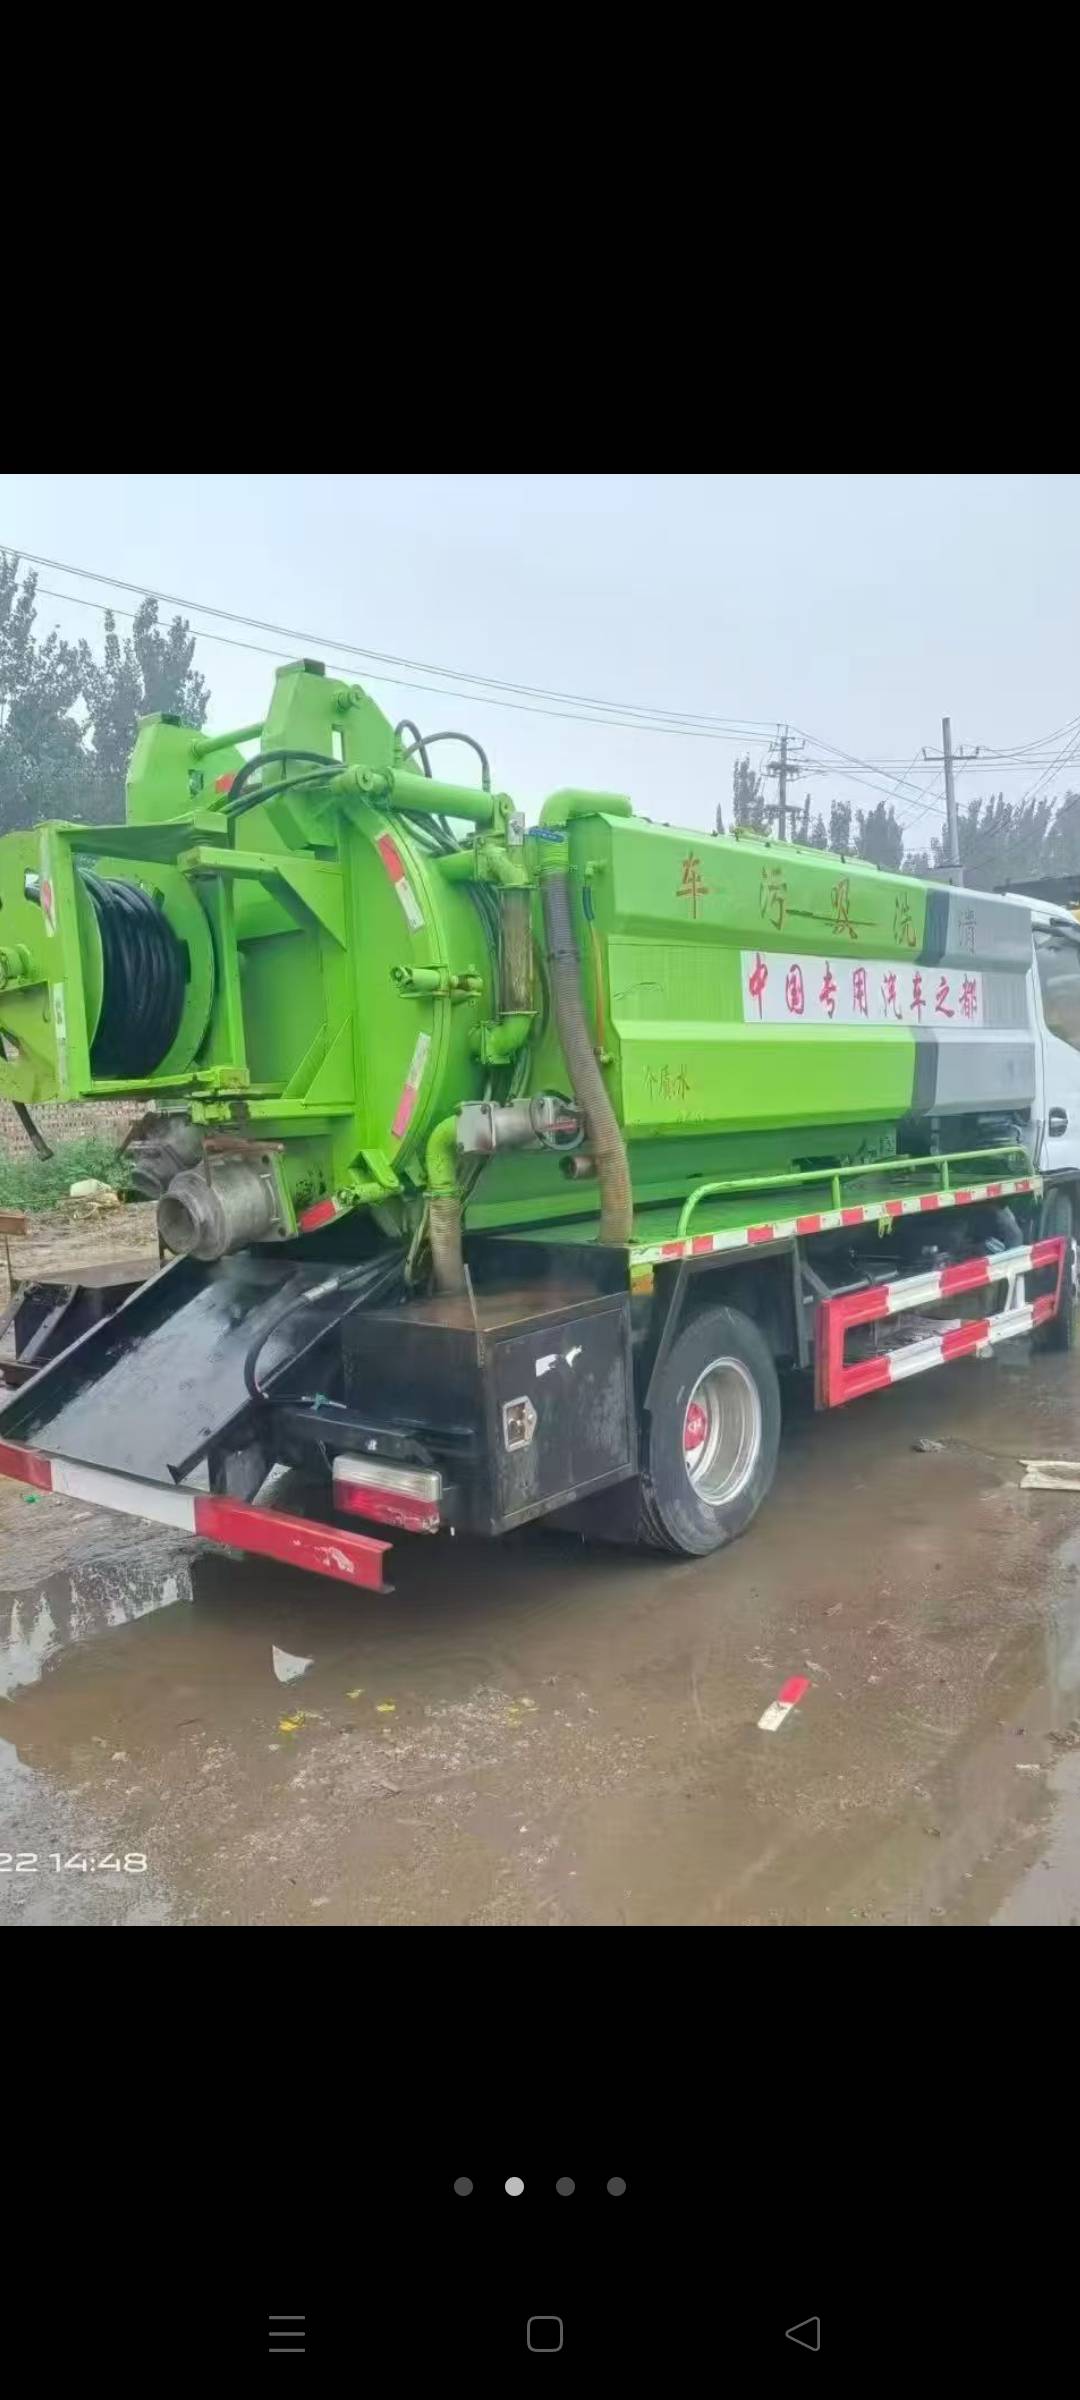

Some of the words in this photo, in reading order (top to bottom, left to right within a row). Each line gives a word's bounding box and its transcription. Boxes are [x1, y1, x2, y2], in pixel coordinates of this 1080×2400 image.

[749, 952, 977, 1023] 中国专用汽车之都
